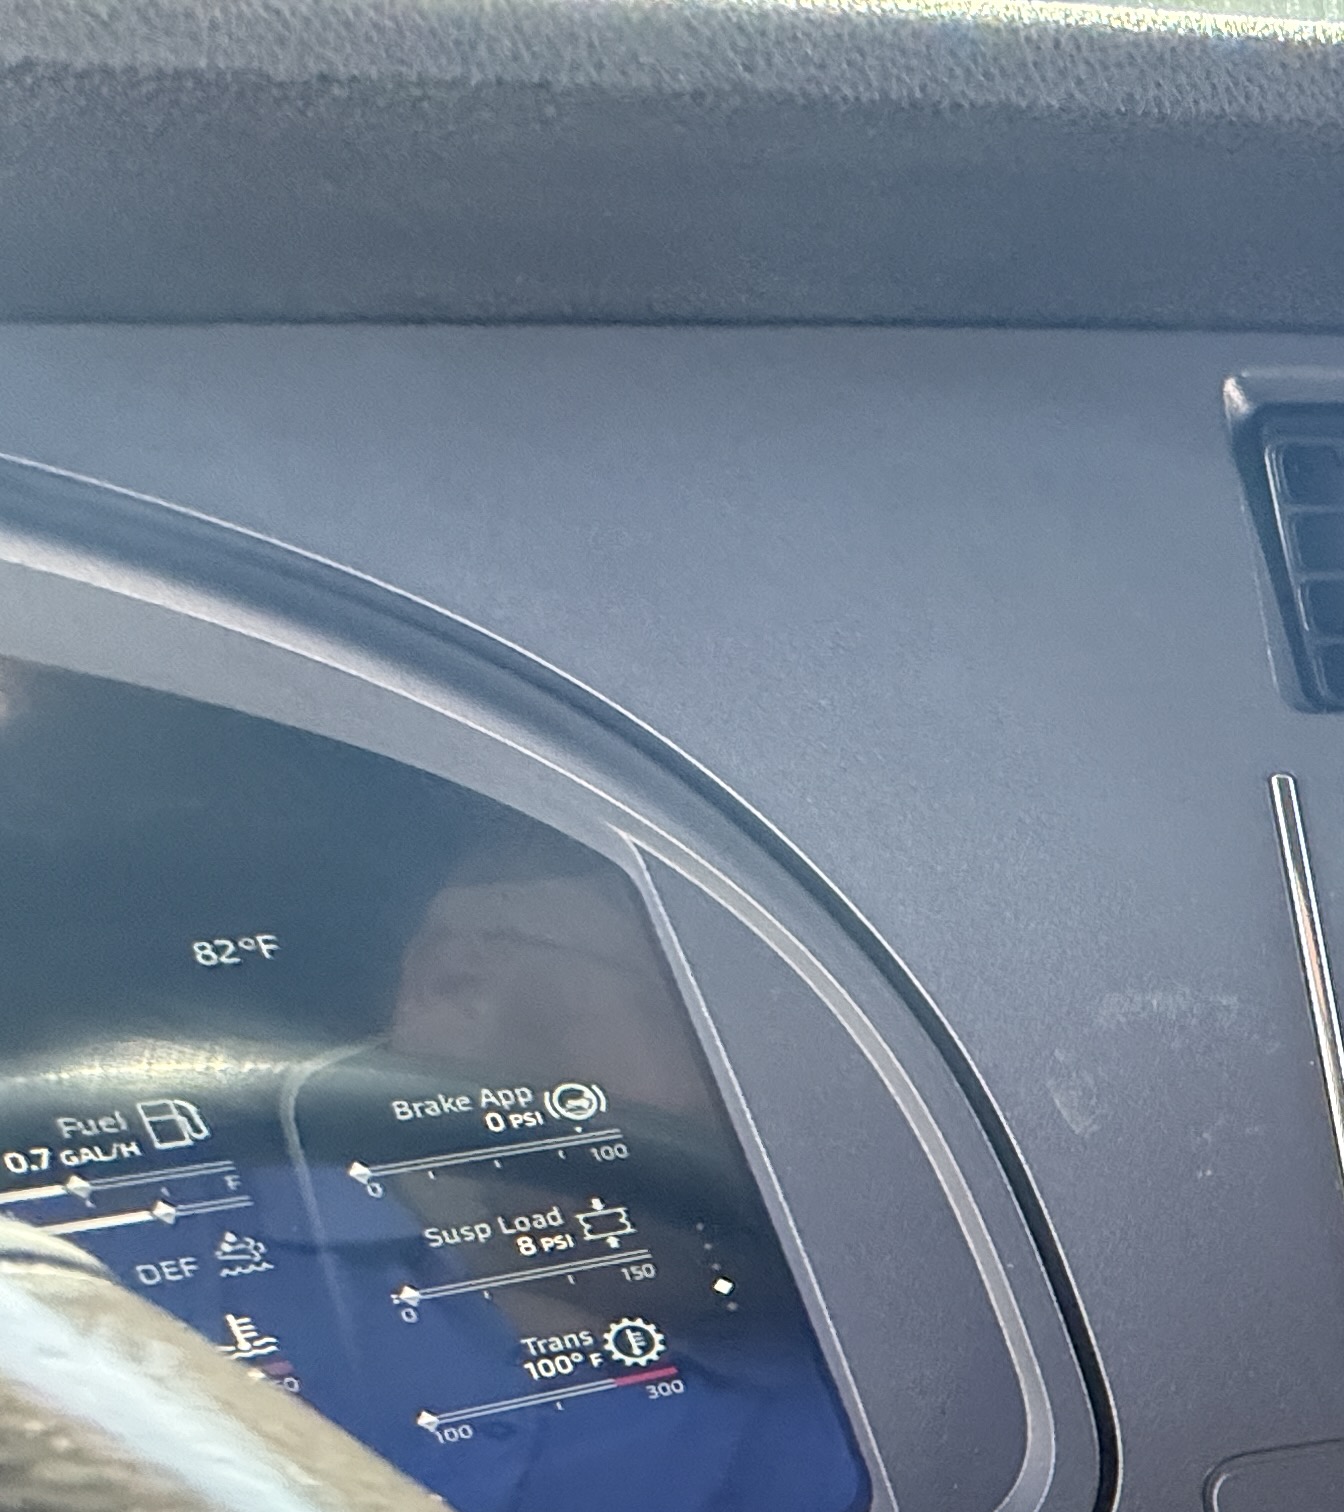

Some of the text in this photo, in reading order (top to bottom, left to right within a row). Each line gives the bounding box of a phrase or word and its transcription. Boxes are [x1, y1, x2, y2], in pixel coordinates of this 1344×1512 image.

[192, 934, 280, 967] 82°F
[391, 1086, 534, 1121] Brake App
[56, 1110, 129, 1139] Fuel
[486, 1110, 545, 1132] 0 PSI
[4, 1140, 143, 1174] 0.7 GAL/H
[591, 1143, 630, 1162] 100
[224, 1174, 242, 1191] F
[367, 1182, 384, 1198] 0
[423, 1206, 564, 1249] Susp Load
[516, 1233, 576, 1257] 8 PSI
[136, 1256, 201, 1286] DEF
[620, 1262, 658, 1282] 150
[401, 1307, 419, 1324] 0
[520, 1330, 595, 1357] Trans
[645, 1378, 685, 1401] 300
[435, 1423, 473, 1446] 100
